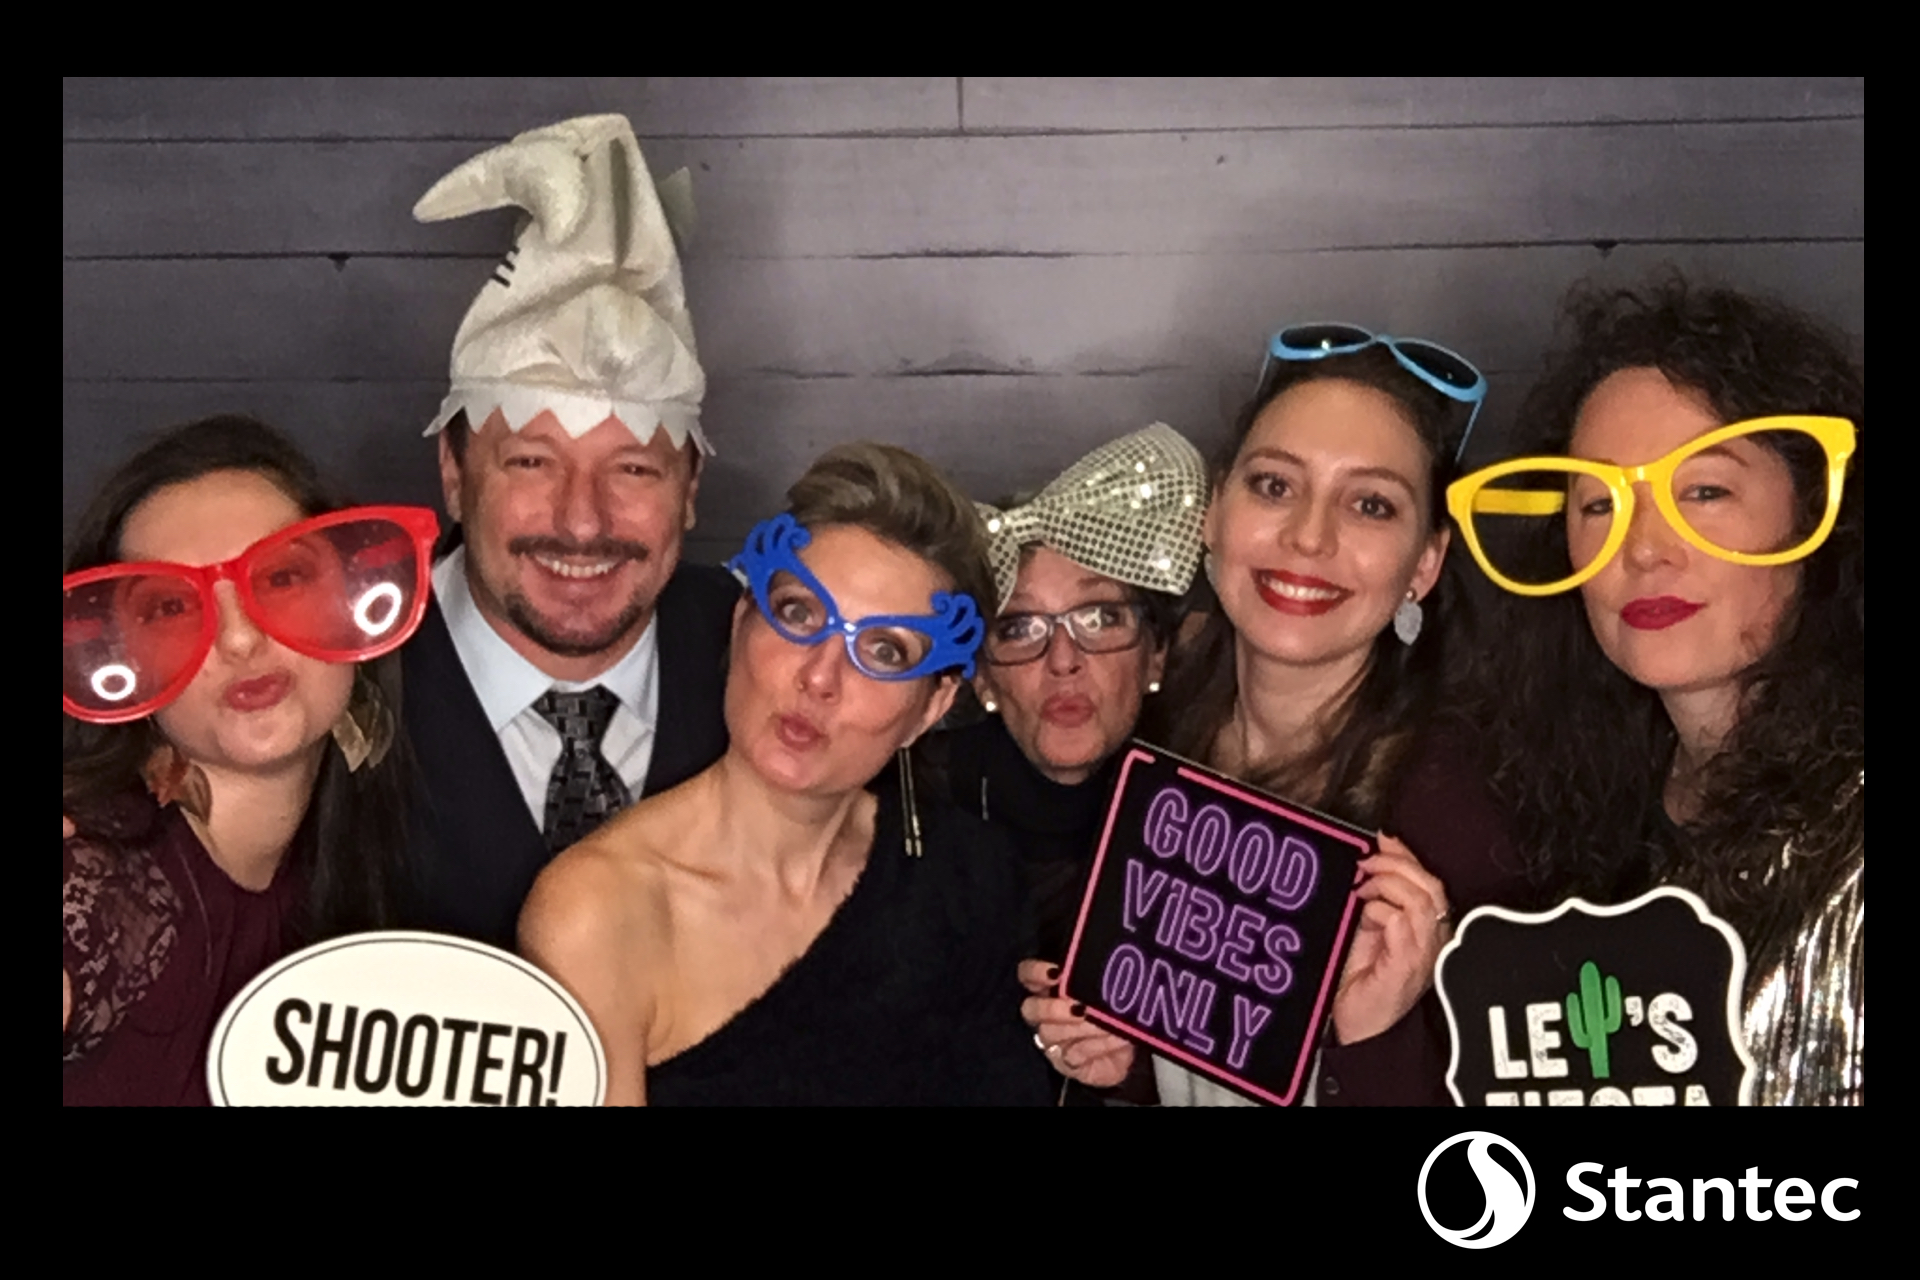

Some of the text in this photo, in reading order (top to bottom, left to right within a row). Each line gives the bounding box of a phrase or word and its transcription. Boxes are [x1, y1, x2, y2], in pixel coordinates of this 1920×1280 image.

[1143, 787, 1319, 911] GOOD
[1122, 858, 1301, 995] VIBES
[265, 997, 568, 1107] SHOOTER!
[1101, 943, 1272, 1070] ONLY
